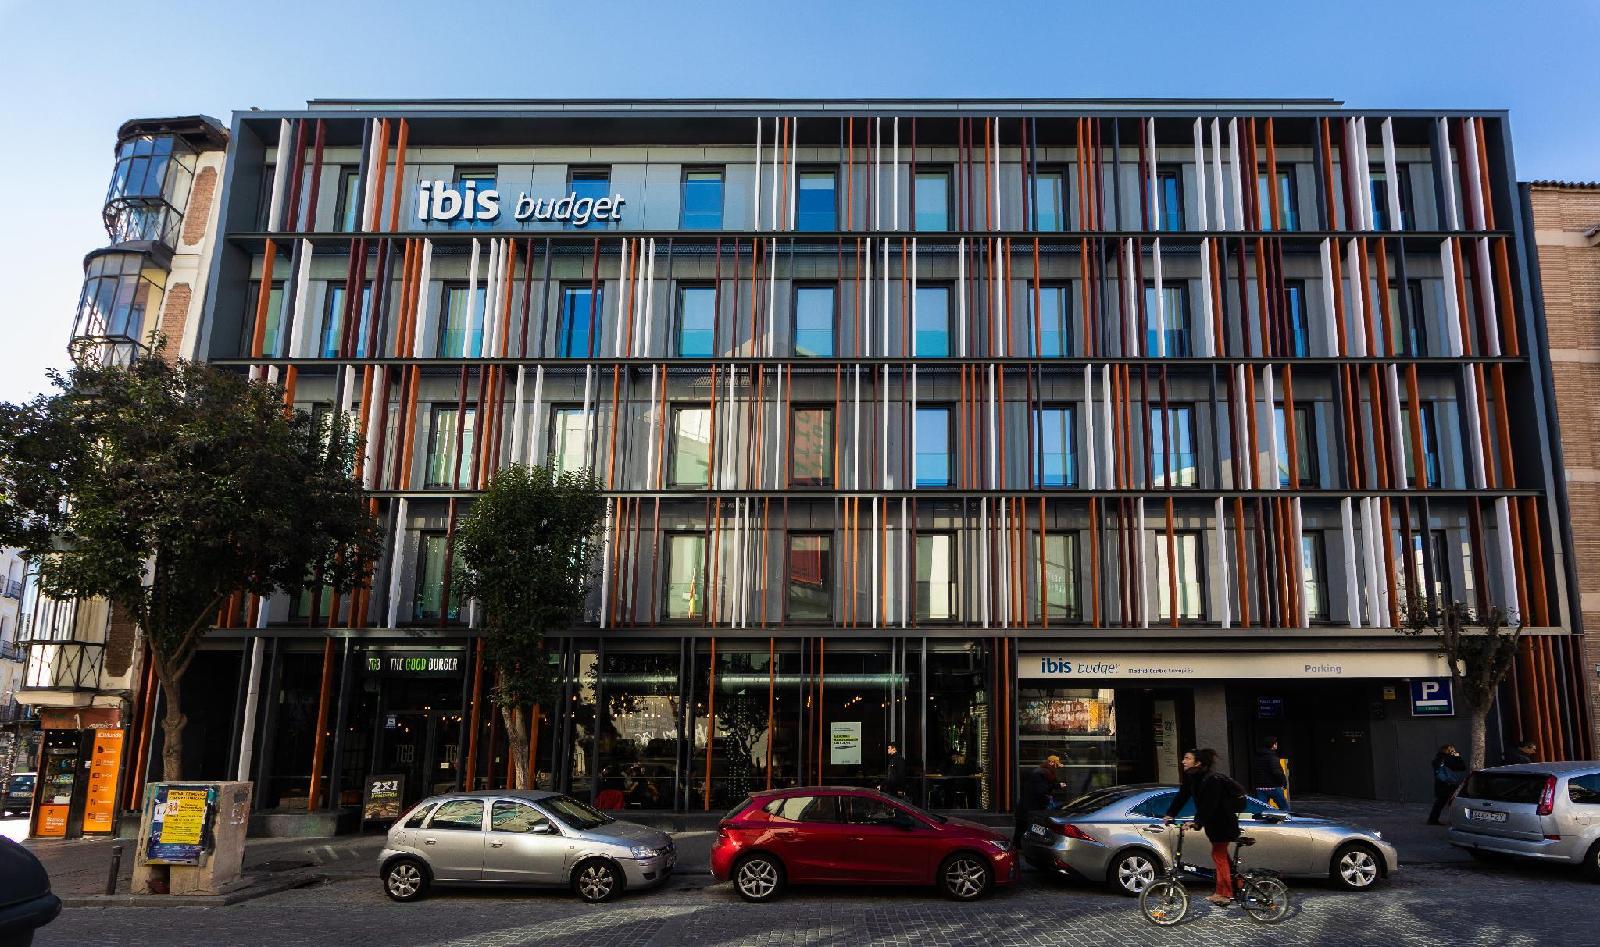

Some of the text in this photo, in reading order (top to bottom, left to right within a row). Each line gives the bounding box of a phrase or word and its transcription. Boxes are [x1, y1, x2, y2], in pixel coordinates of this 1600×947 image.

[418, 180, 625, 225] ibis budget
[390, 658, 404, 671] THE
[405, 658, 427, 671] GOOD
[428, 658, 458, 671] BURGER
[1041, 657, 1120, 675] ibis budget
[1304, 664, 1342, 674] Parking
[1422, 681, 1440, 700] P
